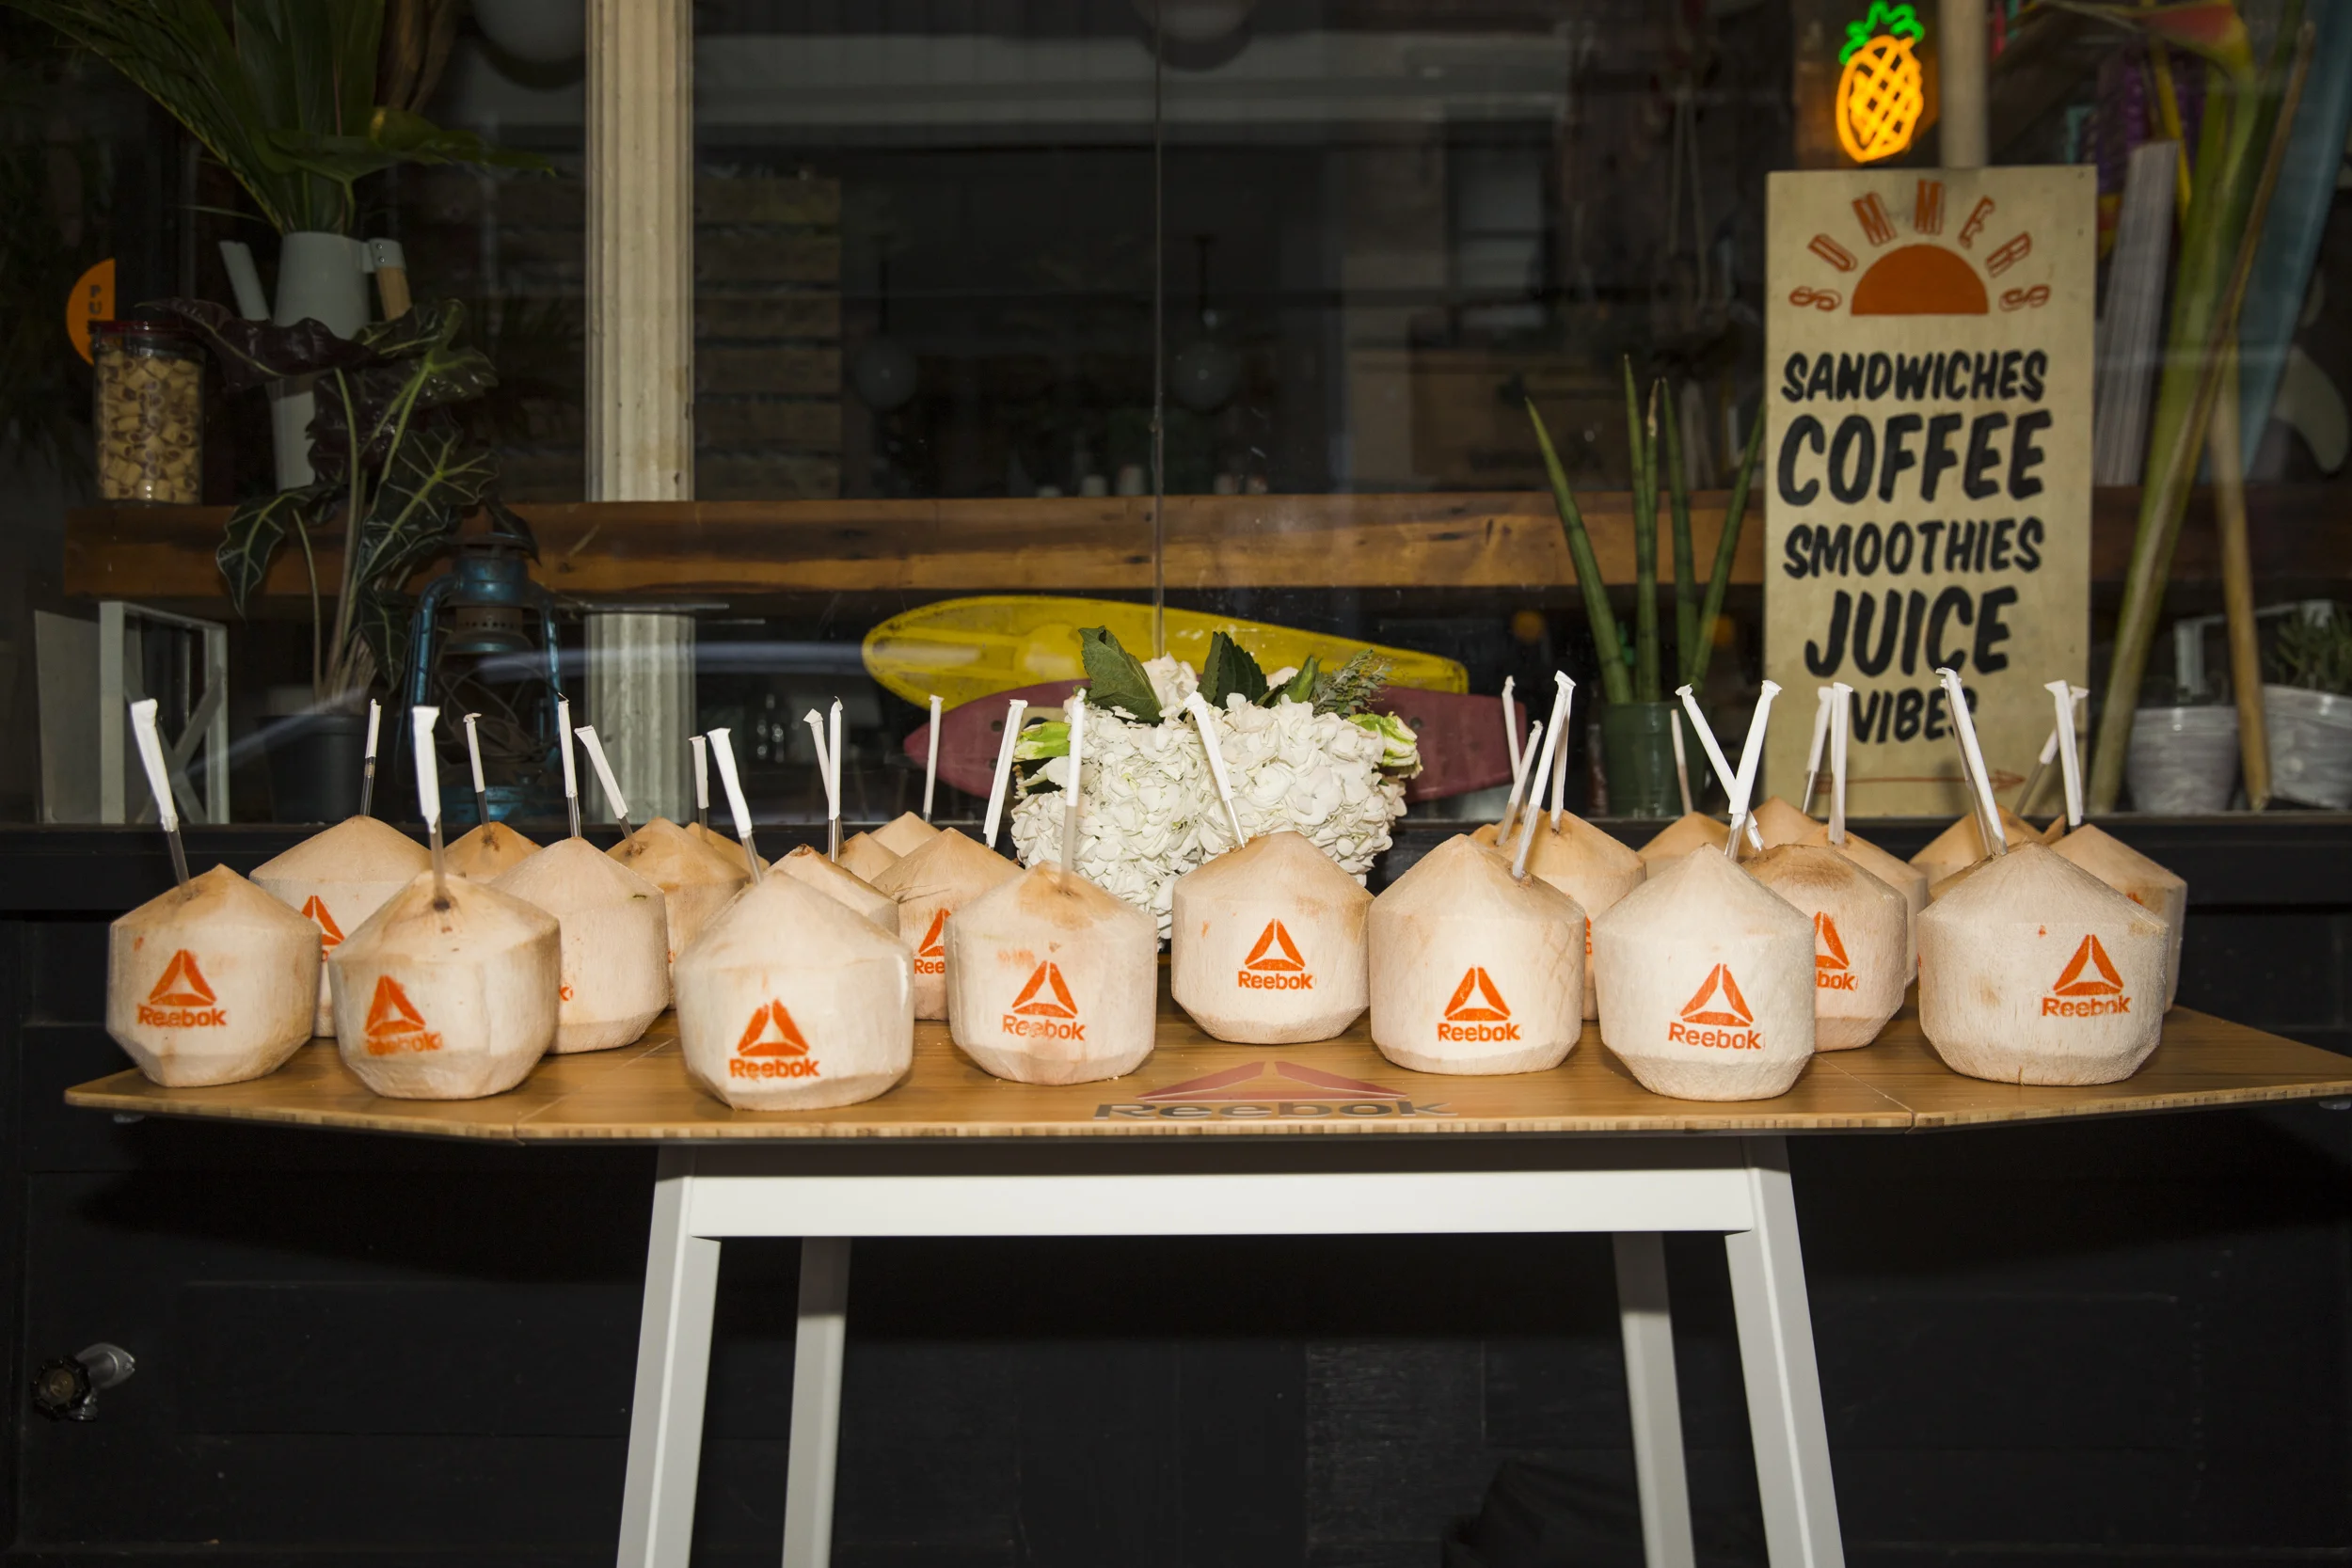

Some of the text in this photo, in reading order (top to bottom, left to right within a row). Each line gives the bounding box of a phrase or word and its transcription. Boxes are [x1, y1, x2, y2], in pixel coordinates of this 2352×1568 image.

[1781, 350, 2048, 403] SANDWICHES
[1778, 409, 2053, 506] COFFEE
[1783, 516, 2044, 578] SMOOTHIES
[1804, 586, 2018, 677] JUICE
[914, 958, 945, 974] Ree
[1237, 970, 1313, 990] Reebok
[1815, 971, 1855, 991] bok
[136, 1004, 227, 1028] Reebok
[2041, 995, 2132, 1019] Reebok
[1002, 1013, 1087, 1041] Reebok
[1437, 1022, 1521, 1043] Reebok
[1668, 1022, 1762, 1051] Reebok
[729, 1056, 820, 1079] Reebok
[1093, 1101, 1459, 1120] Reebok
